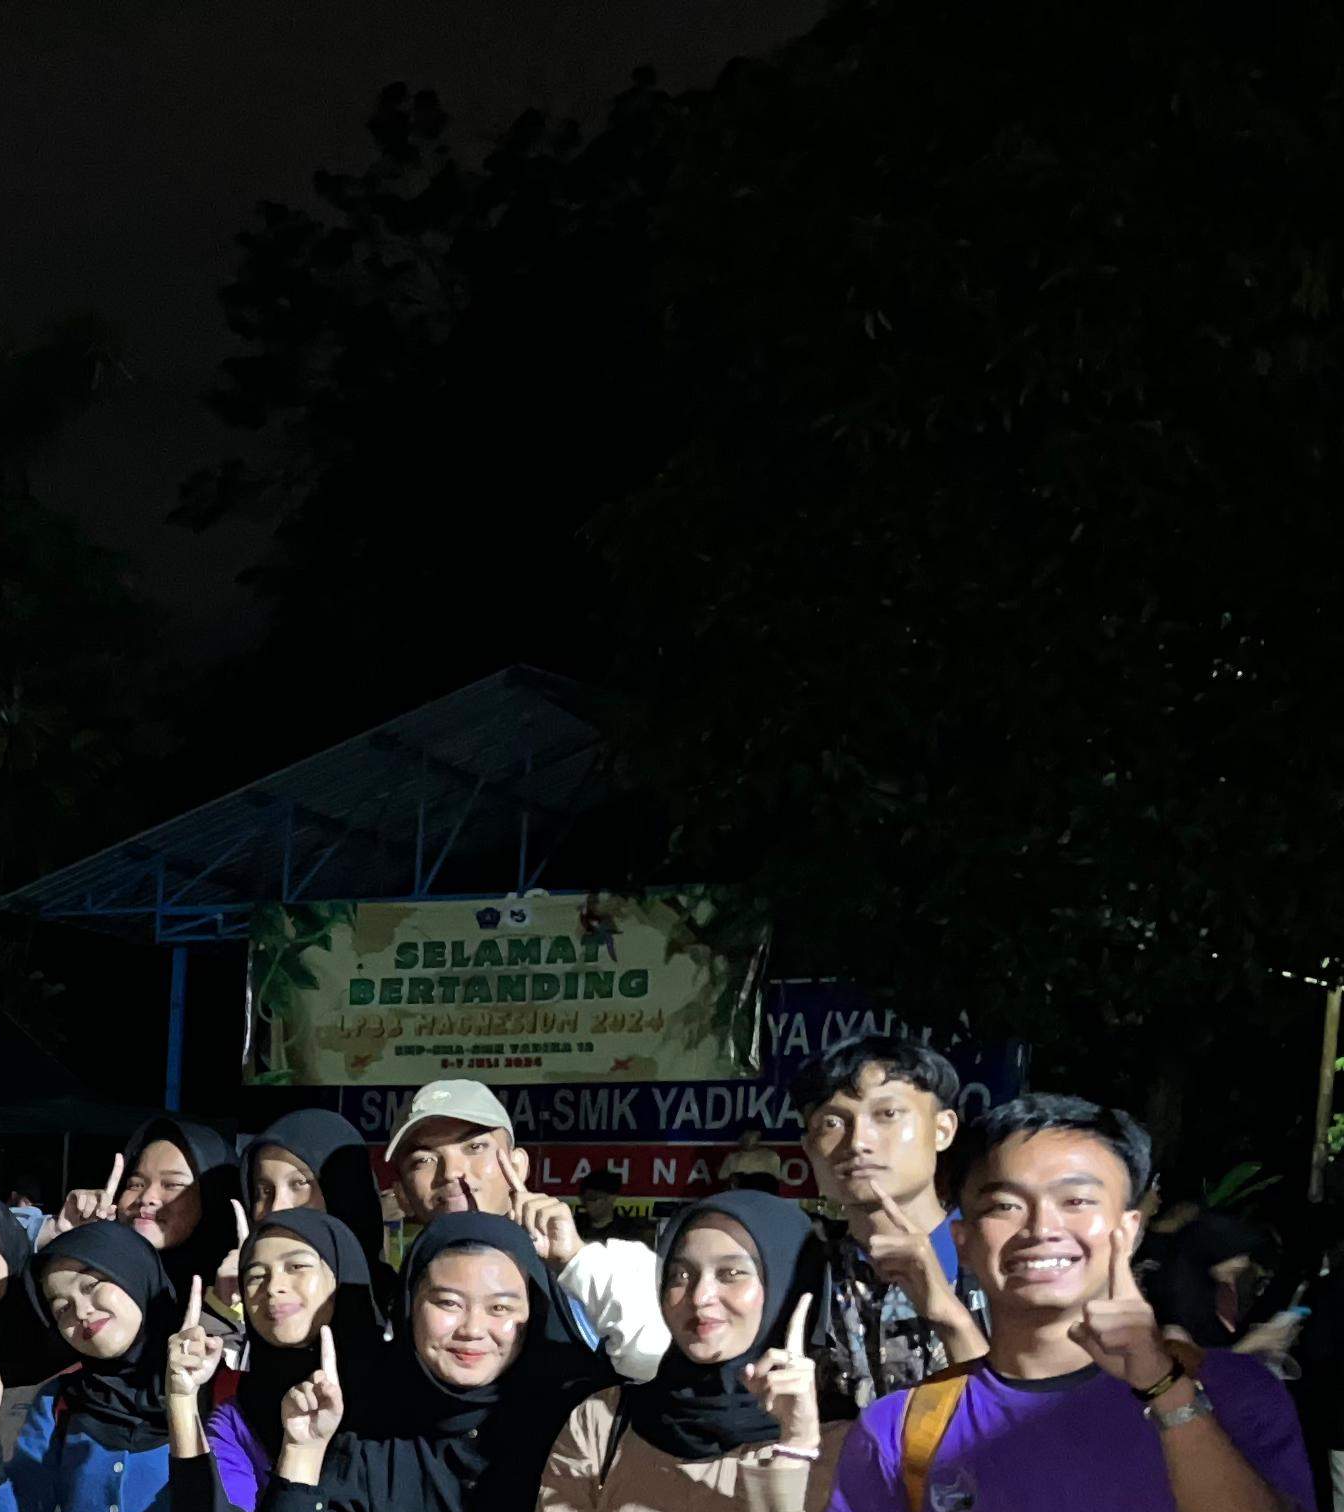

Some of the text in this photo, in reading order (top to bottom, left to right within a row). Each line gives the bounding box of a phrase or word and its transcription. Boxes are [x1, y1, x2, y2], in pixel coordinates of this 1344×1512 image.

[395, 934, 604, 969] SELAMAT
[349, 969, 649, 1005] BERTANDING
[414, 1009, 579, 1037] MAGNESIUM
[590, 1008, 665, 1034] 2024
